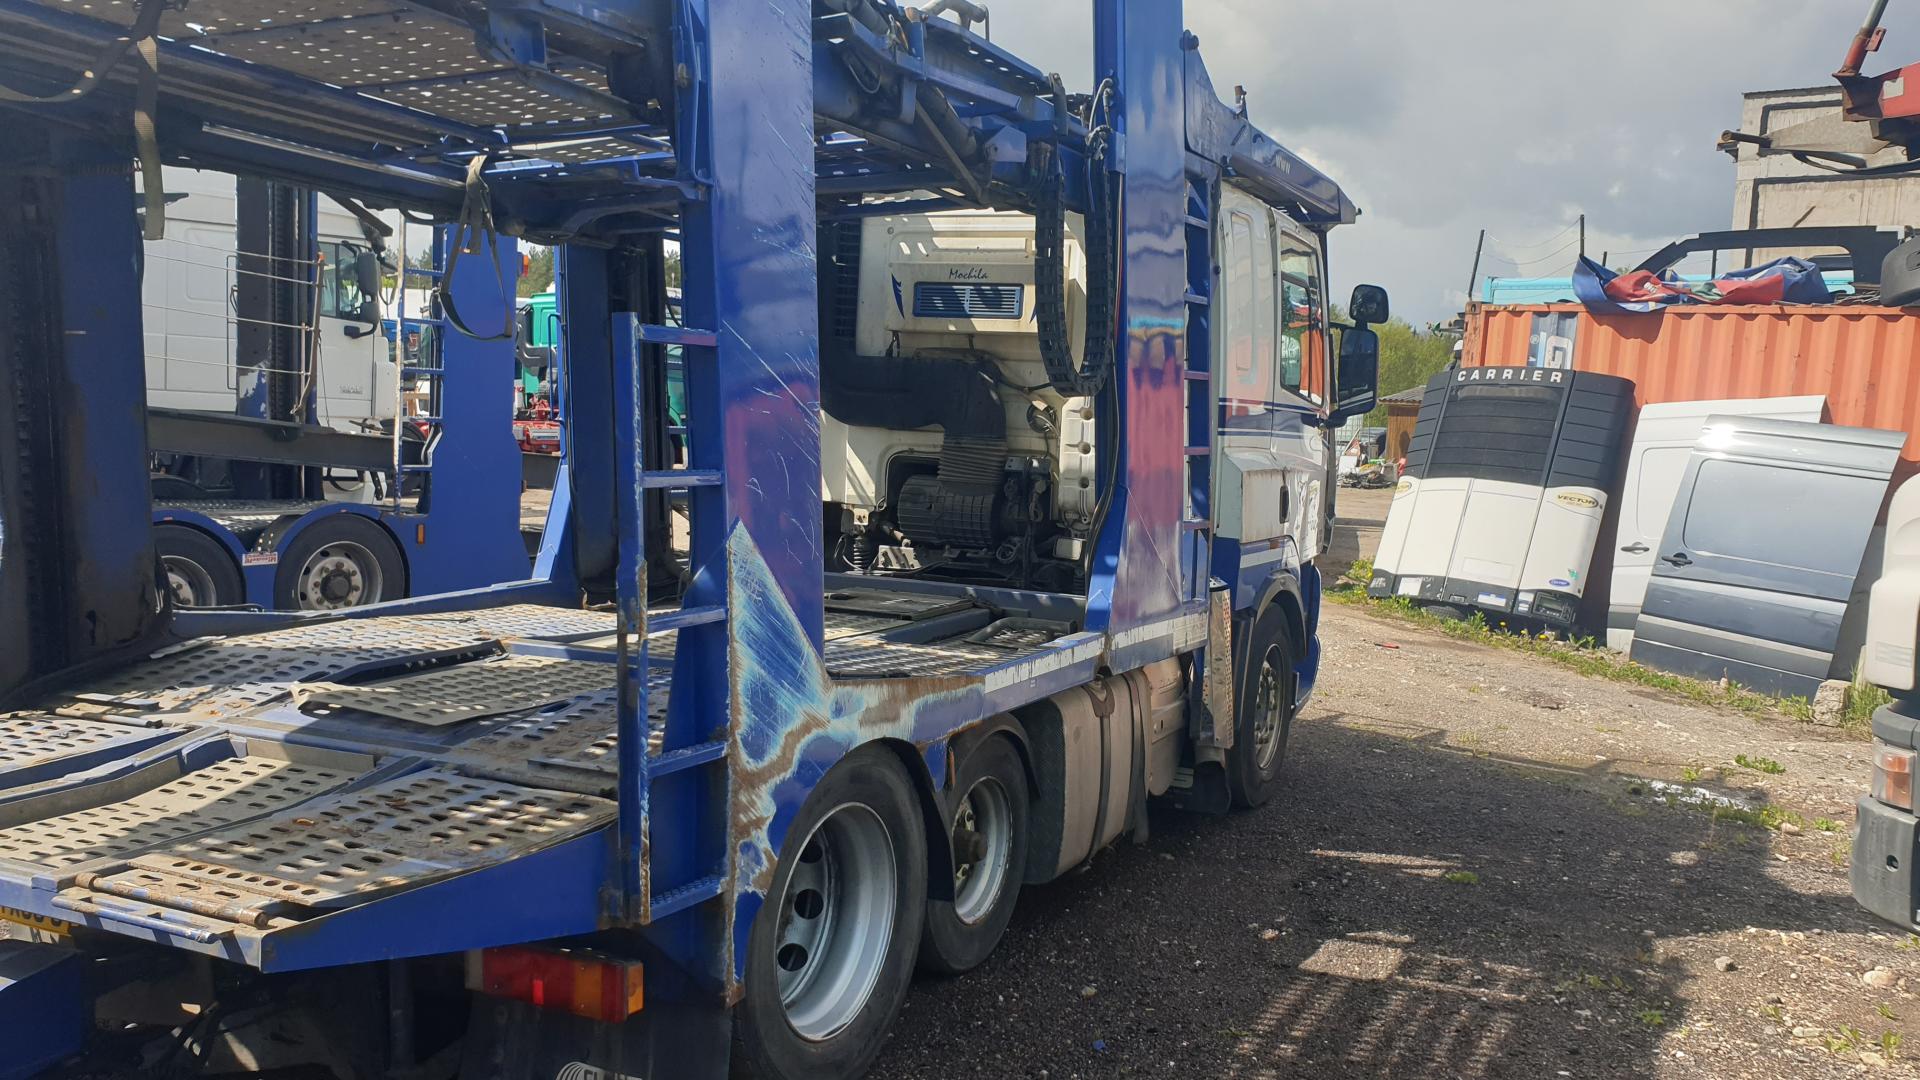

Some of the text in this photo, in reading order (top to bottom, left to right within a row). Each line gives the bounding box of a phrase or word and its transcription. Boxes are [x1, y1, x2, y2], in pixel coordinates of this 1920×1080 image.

[948, 268, 988, 280] Mochila
[1457, 369, 1563, 383] CARRIER
[1557, 494, 1596, 505] VECTOR
